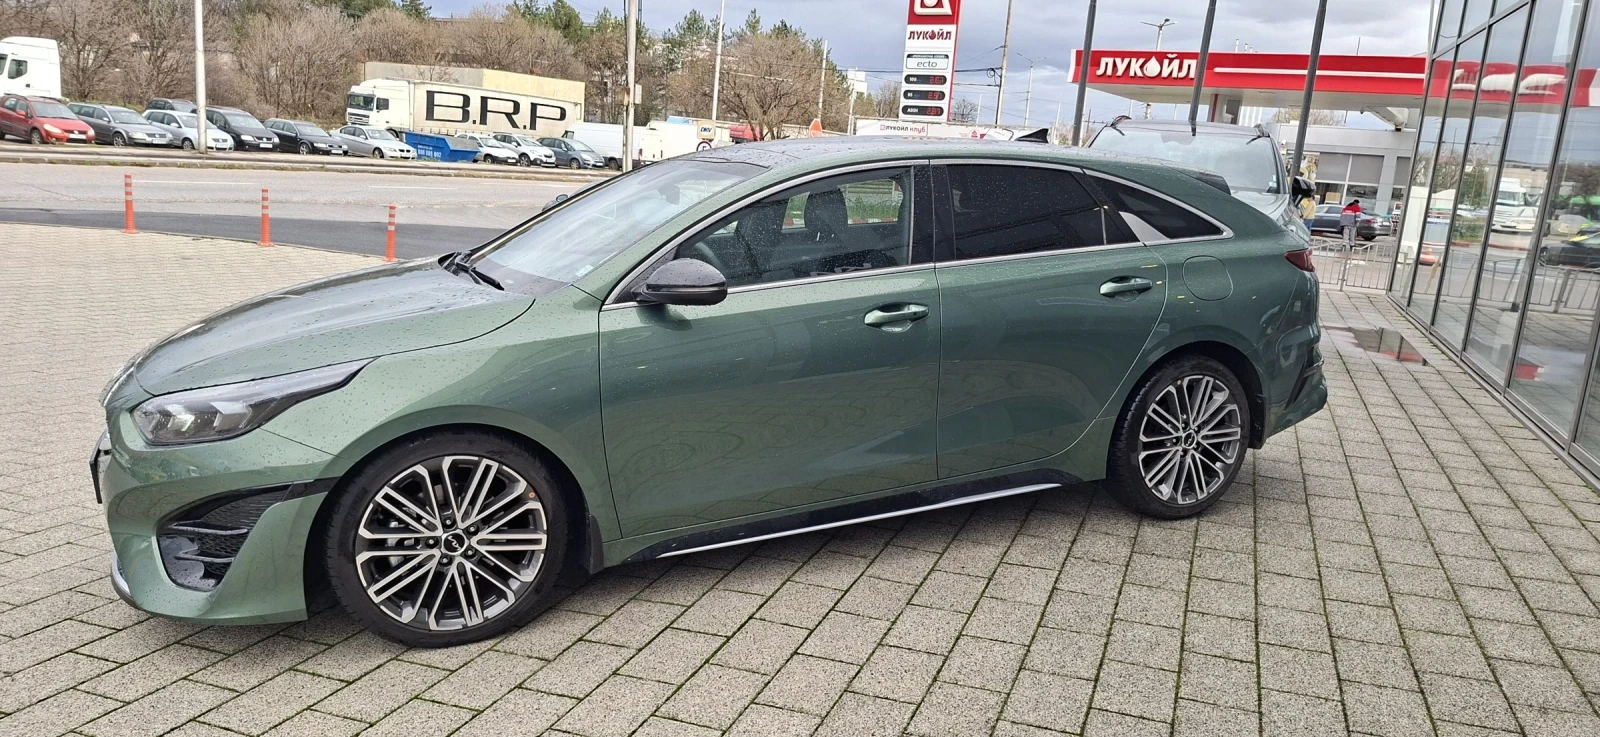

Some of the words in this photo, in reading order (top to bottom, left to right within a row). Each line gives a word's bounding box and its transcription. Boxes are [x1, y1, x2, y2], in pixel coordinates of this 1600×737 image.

[908, 28, 951, 40] ЛУКОЙЛ
[916, 60, 938, 68] ecto
[1096, 54, 1197, 79] ЛУКОЙЛ
[425, 90, 567, 131] B.R.P
